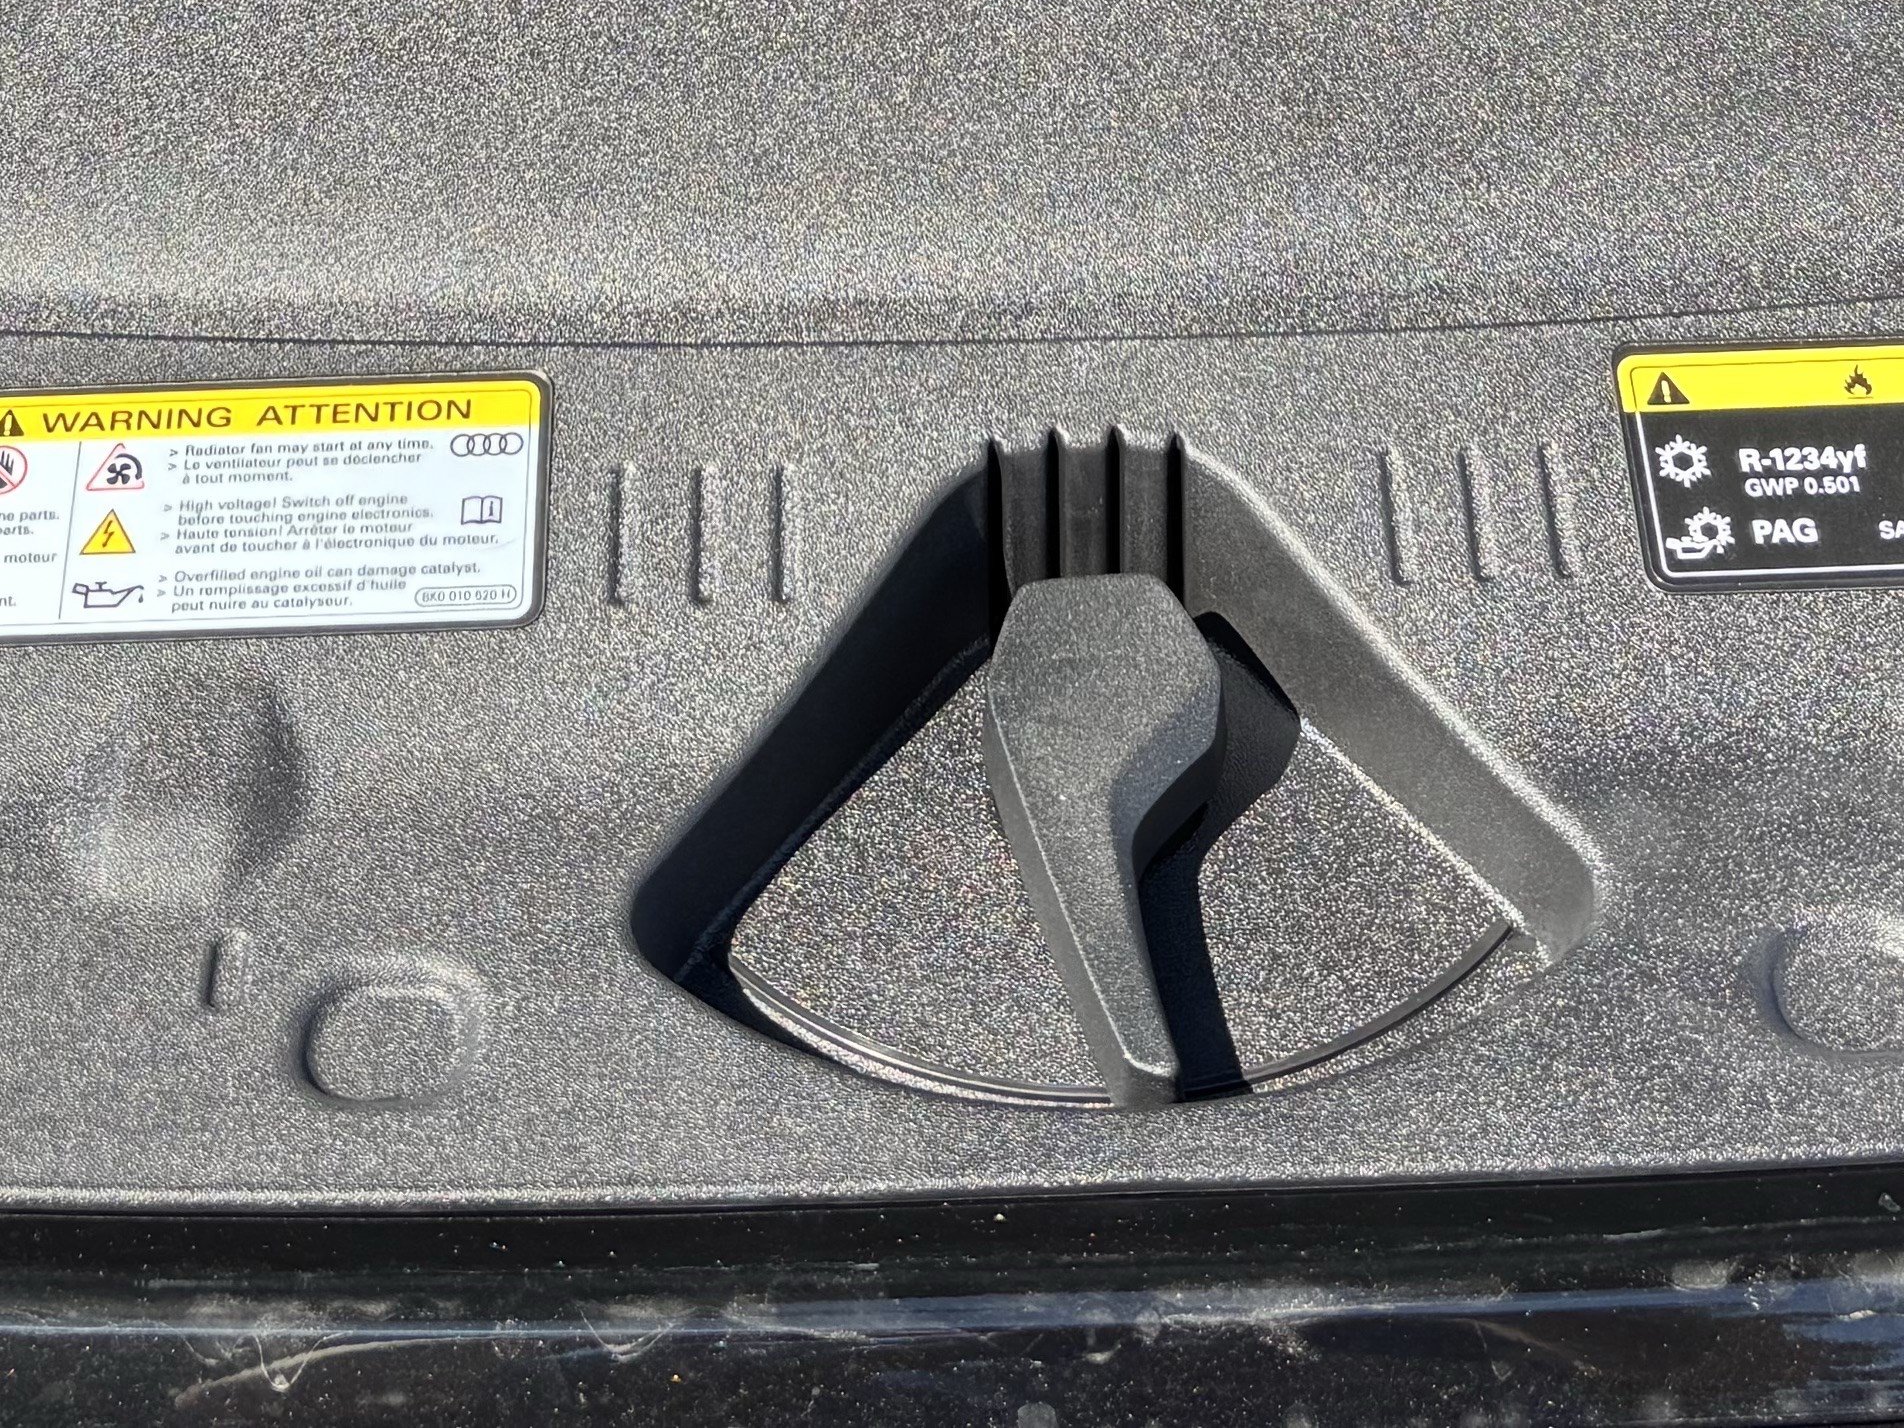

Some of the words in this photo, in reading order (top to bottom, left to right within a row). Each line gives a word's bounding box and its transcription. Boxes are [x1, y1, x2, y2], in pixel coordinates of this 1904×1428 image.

[43, 406, 232, 433] WARNING
[257, 398, 472, 426] ATTENTION
[185, 443, 247, 457] Radiator
[251, 442, 273, 455] fan
[277, 443, 309, 456] may
[313, 440, 345, 453] start
[349, 440, 362, 452] at
[367, 440, 393, 452] any
[398, 438, 433, 450] time.
[184, 459, 201, 470] Le
[205, 456, 281, 470] ventilateur
[286, 455, 319, 468] peut
[323, 455, 339, 466] se
[343, 452, 422, 465] déclencher
[1738, 444, 1868, 473] R-1234yf
[195, 472, 223, 484] tout
[228, 470, 293, 483] moment.
[1744, 476, 1798, 497] GWP
[1803, 475, 1861, 495] 0.501
[179, 500, 214, 516] High
[217, 497, 277, 511] voltage!
[282, 494, 330, 509] Switch
[336, 494, 355, 506] off
[358, 493, 408, 507] engine
[20, 510, 60, 524] parts.
[178, 512, 225, 526] before
[229, 510, 293, 526] touching
[297, 509, 347, 524] engine
[351, 507, 434, 520] electronics.
[176, 527, 219, 540] Haute
[288, 524, 338, 537] Arrêter
[343, 523, 356, 535] le
[360, 521, 414, 534] moteur
[1753, 516, 1819, 546] PAG
[175, 541, 215, 555] avant
[220, 541, 238, 553] de
[242, 539, 298, 552] toucher
[420, 534, 438, 547] du
[442, 533, 499, 546] moteur.
[4, 552, 58, 564] moteur
[174, 568, 246, 583] Overfilled
[251, 567, 301, 582] engine
[304, 566, 322, 578] oil
[327, 566, 353, 578] can
[357, 563, 417, 579] damage
[421, 561, 481, 575] catalyst.
[173, 584, 195, 597] Un
[199, 581, 289, 598] remplissage
[293, 579, 352, 594] excessif
[356, 578, 407, 591] d'huile
[171, 597, 205, 612] peut
[209, 596, 247, 610] nuire
[251, 597, 270, 609] au
[273, 594, 352, 610] catalyseur.
